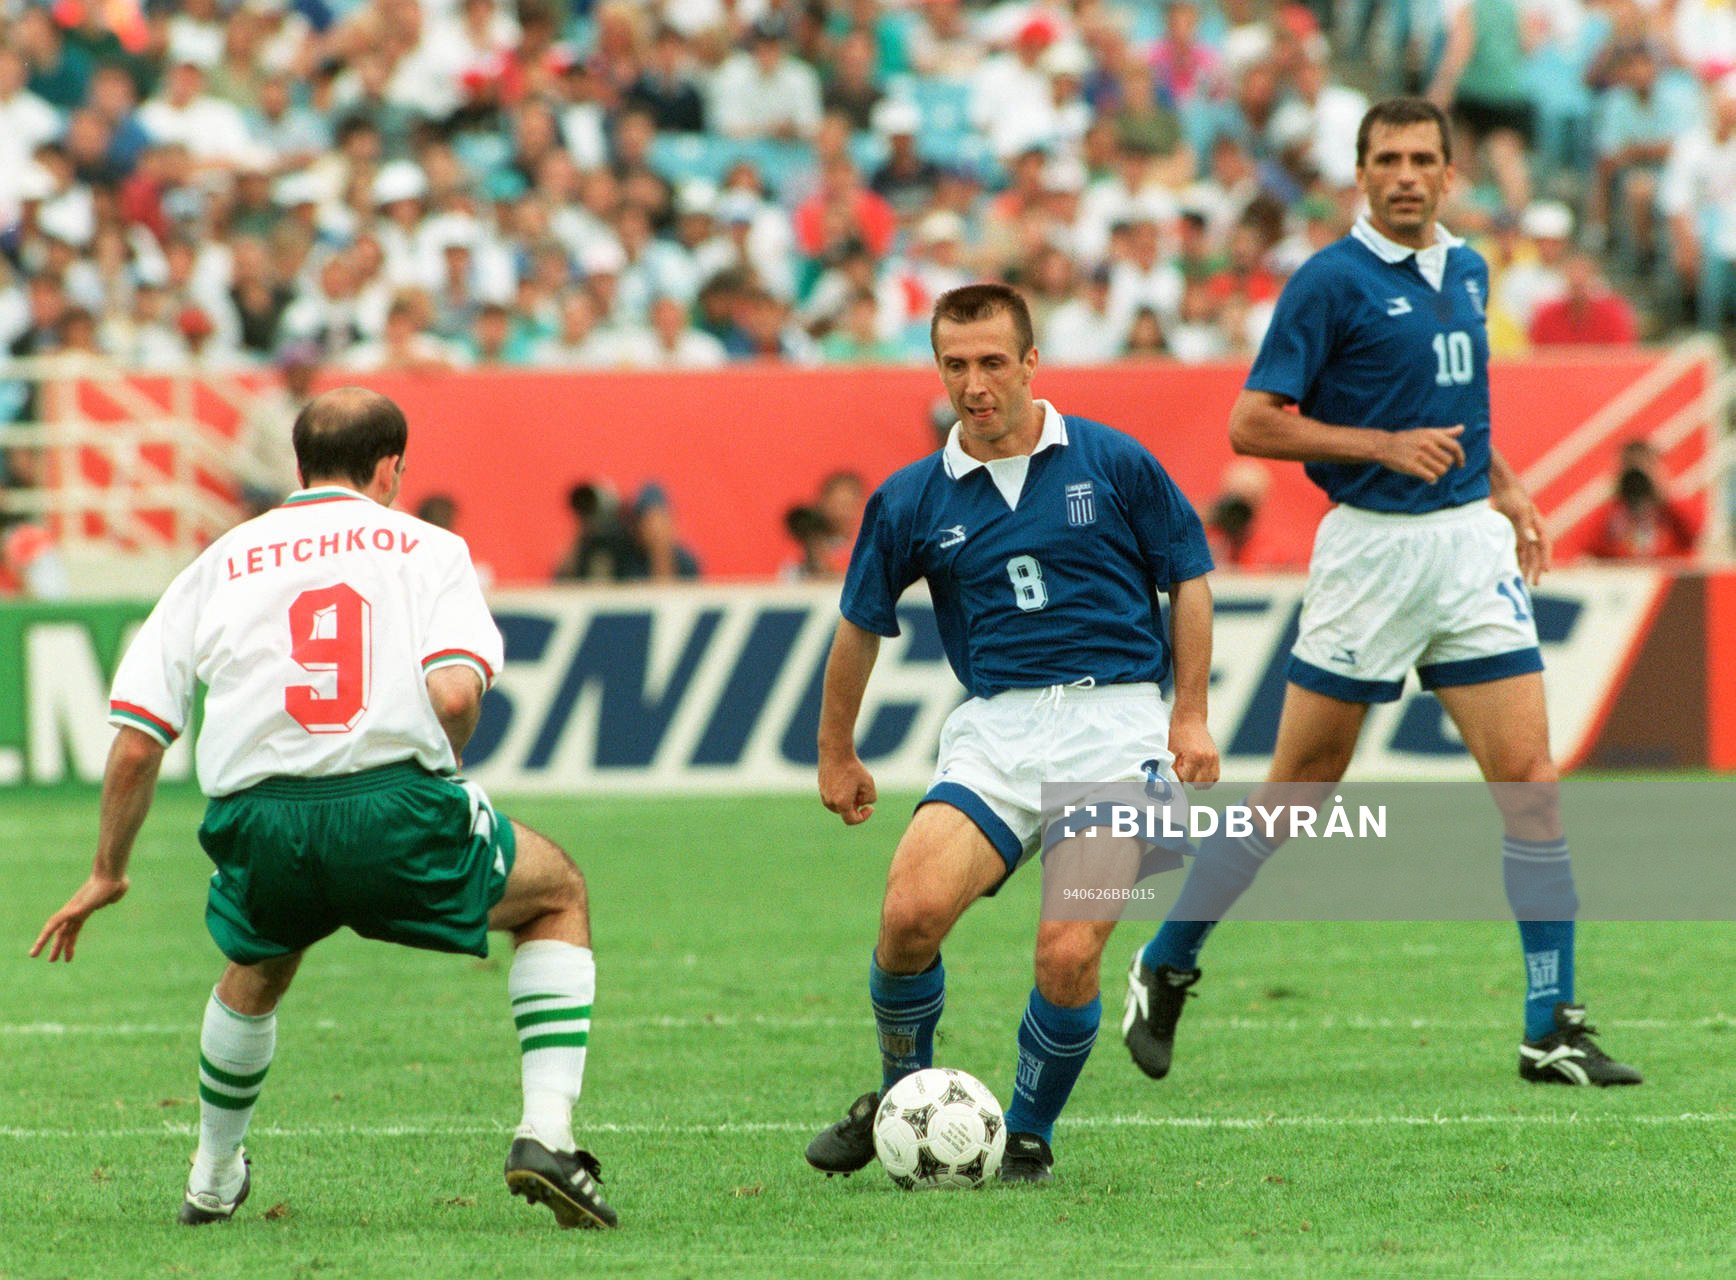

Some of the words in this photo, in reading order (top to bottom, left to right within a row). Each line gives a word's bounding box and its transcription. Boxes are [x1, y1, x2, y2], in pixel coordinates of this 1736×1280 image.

[1432, 331, 1473, 386] 10
[227, 526, 420, 581] LETCHKOV
[1006, 554, 1048, 612] 8
[284, 582, 372, 734] 9
